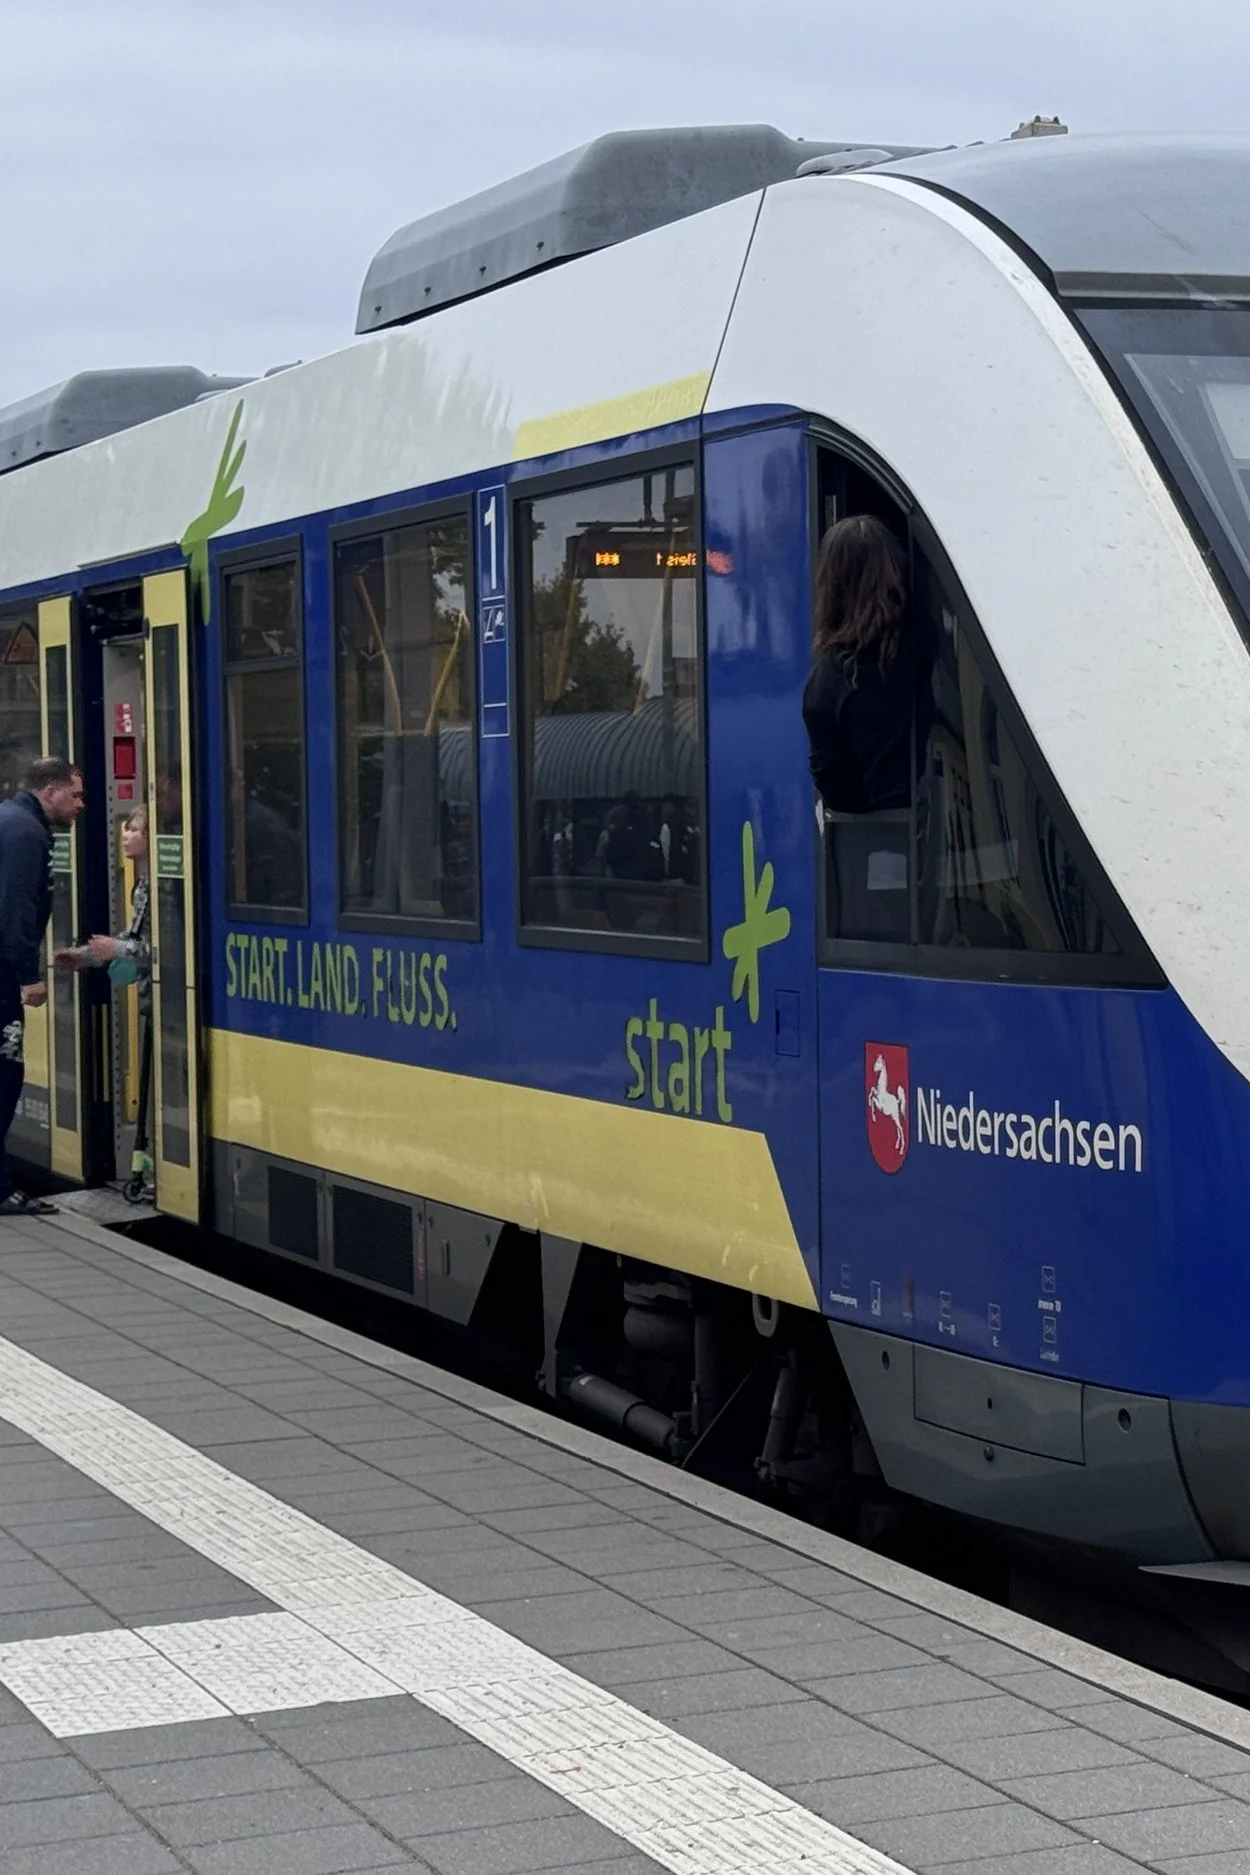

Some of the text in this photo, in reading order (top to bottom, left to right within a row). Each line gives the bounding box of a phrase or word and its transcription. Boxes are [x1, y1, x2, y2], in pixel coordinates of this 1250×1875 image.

[484, 496, 497, 589] 1
[226, 932, 292, 1006] START.
[372, 947, 457, 1031] FLUSS.
[626, 998, 732, 1122] start
[916, 1087, 1142, 1172] Niedersachsen
